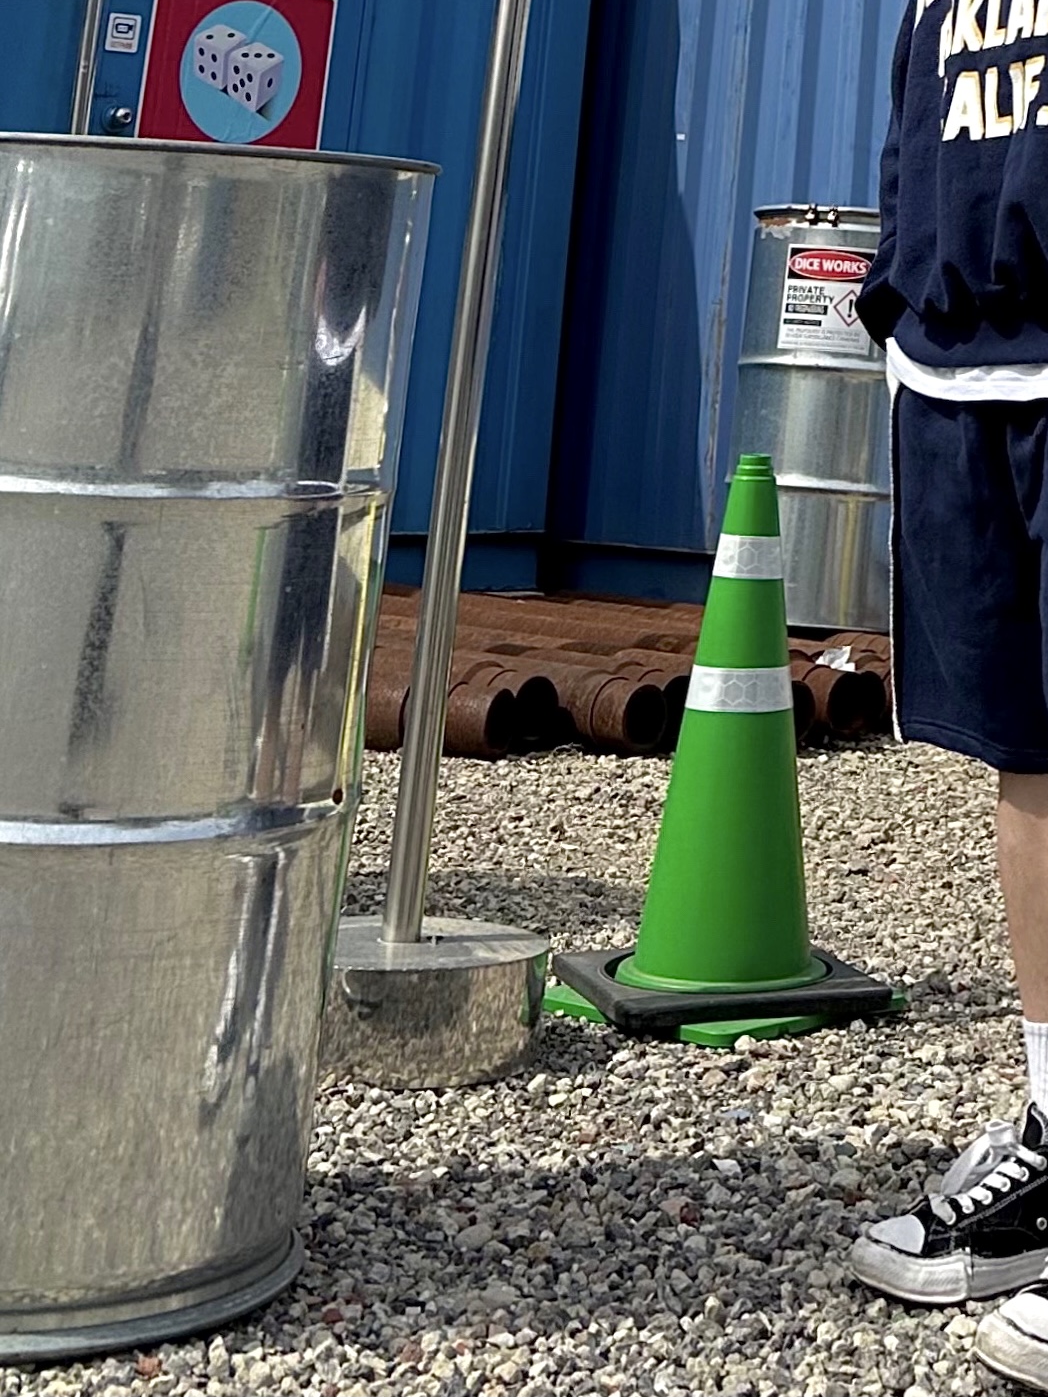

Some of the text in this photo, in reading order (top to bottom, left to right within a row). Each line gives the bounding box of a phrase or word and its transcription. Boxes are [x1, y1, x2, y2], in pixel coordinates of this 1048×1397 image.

[794, 257, 868, 274] DICE WORKS
[787, 285, 825, 294] PRIVATE
[786, 293, 835, 304] PROPERTY
